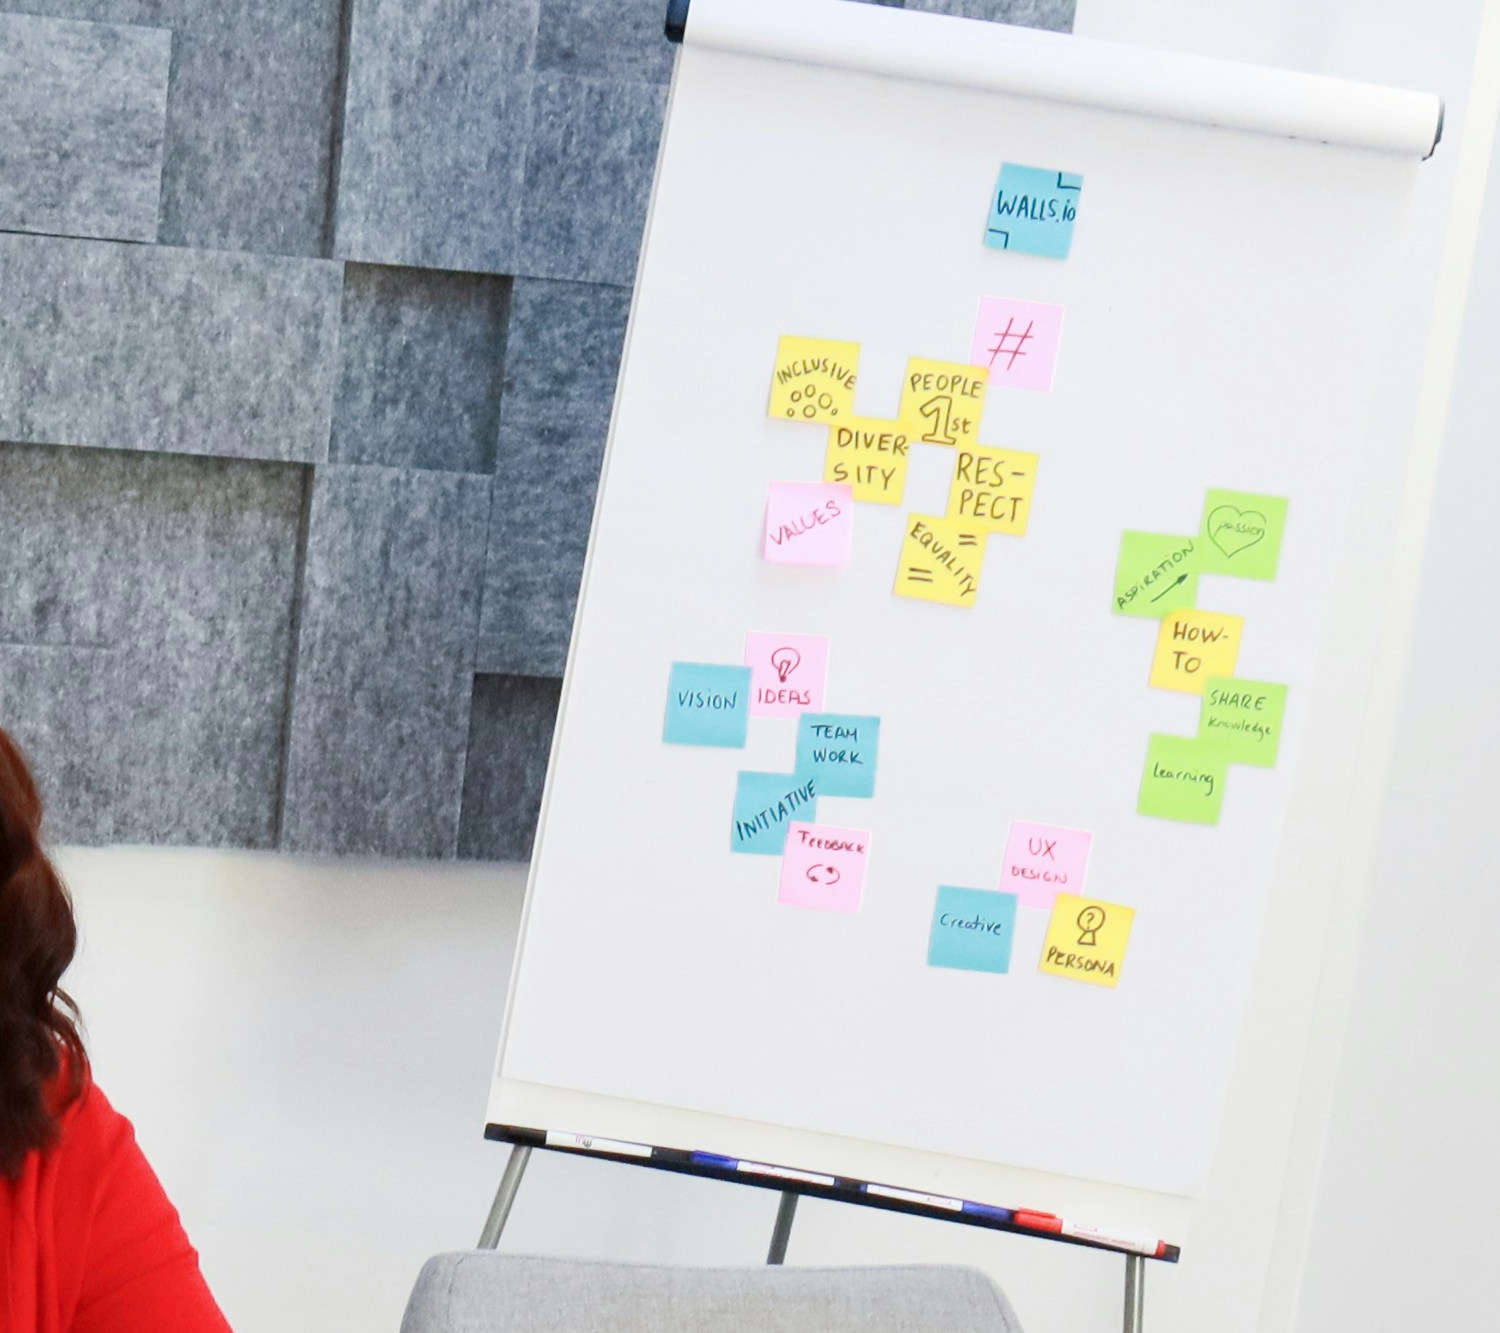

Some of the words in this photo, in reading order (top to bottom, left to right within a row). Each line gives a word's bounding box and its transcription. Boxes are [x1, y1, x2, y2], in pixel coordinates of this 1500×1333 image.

[987, 316, 1034, 371] #
[777, 358, 857, 390] INCLUSIVE
[910, 373, 983, 398] PEOPLE
[837, 427, 910, 456] DIVER-
[834, 463, 896, 491] SITY
[957, 452, 1025, 487] RES-
[959, 489, 1024, 523] PECT
[770, 500, 841, 546] VALUES
[910, 521, 977, 597] EQUALITY
[1173, 621, 1229, 643] HOW-
[1173, 650, 1201, 673] TO
[758, 688, 811, 705] IDEAS
[1210, 689, 1267, 711] SHARE
[810, 724, 858, 743] TEAM
[813, 750, 863, 765] WORK
[735, 779, 817, 841] INITIATIVE
[1028, 837, 1057, 861] UX
[1011, 865, 1068, 884] DESIGN
[940, 912, 1002, 936] Creative
[1046, 946, 1115, 978] PERSONA
